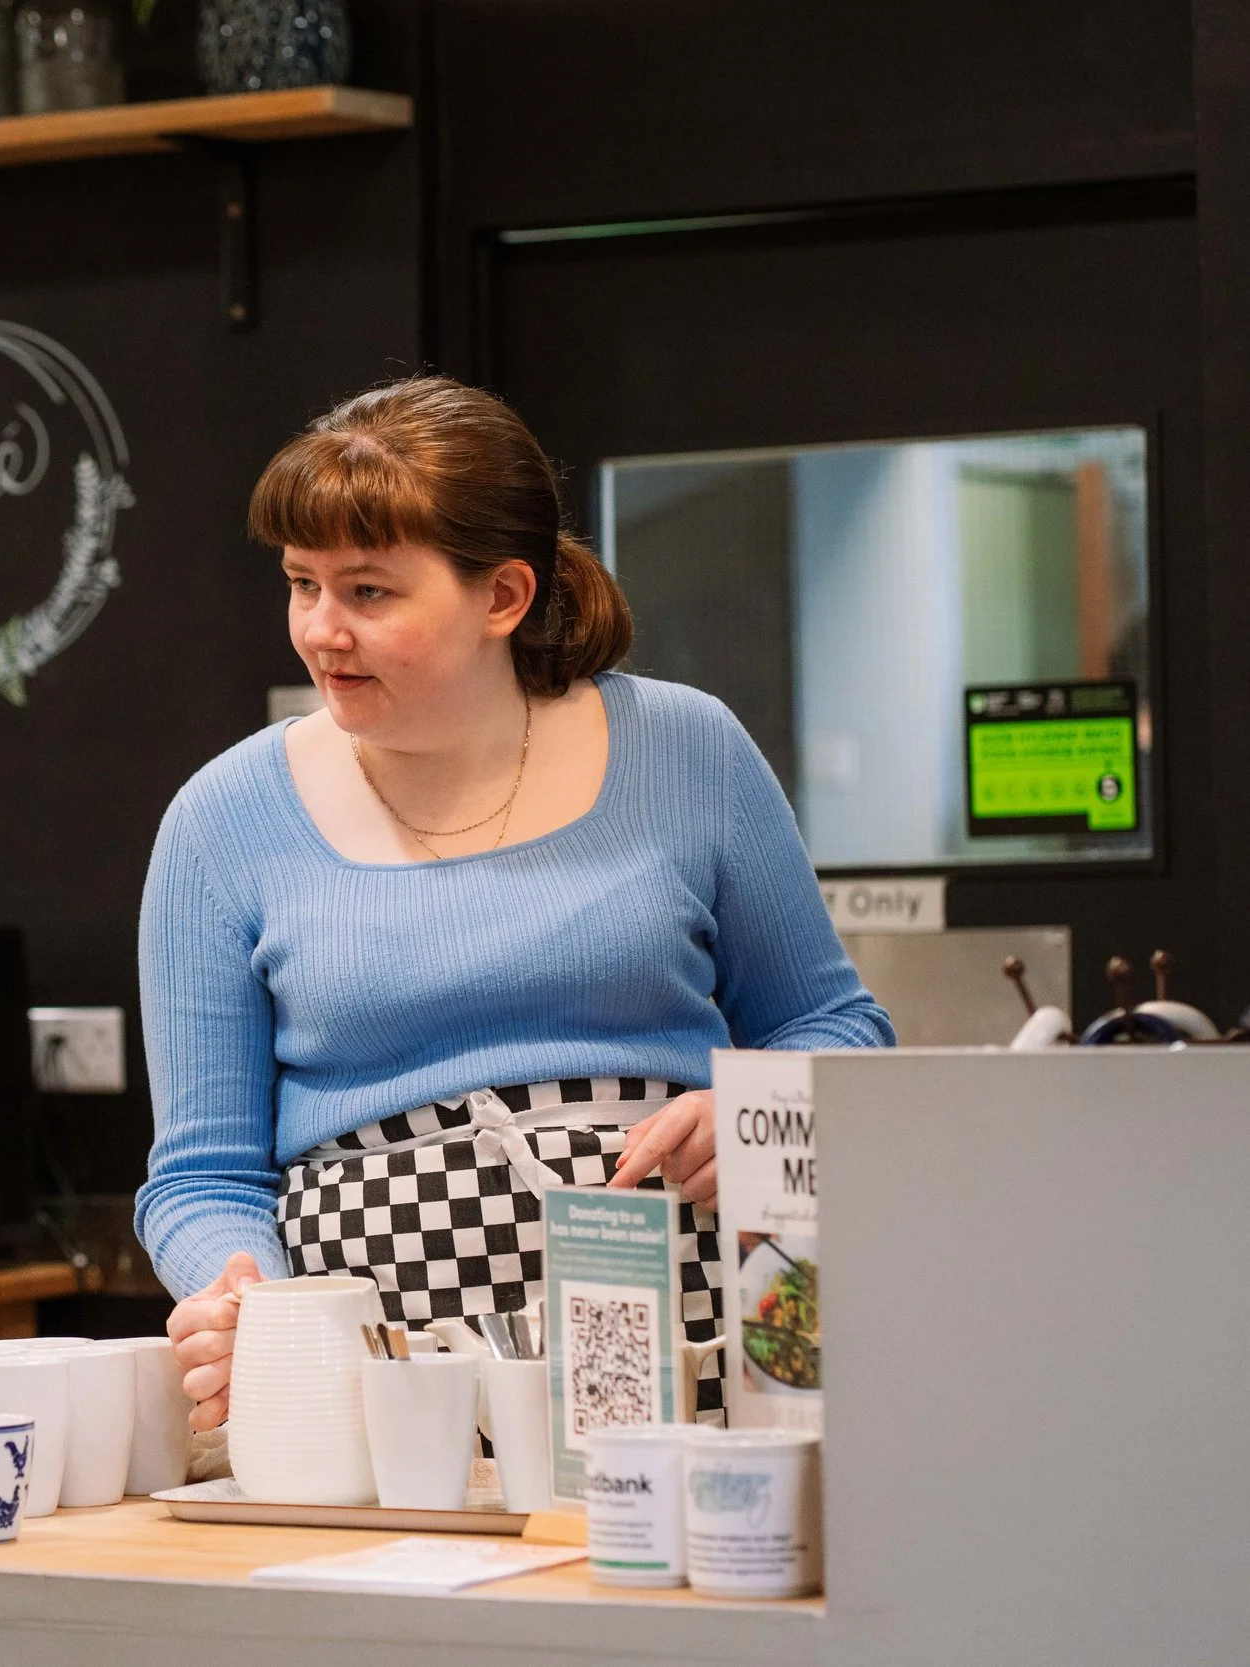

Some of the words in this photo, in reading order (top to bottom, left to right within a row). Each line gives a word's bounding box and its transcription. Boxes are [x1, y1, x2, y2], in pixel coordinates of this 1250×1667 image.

[847, 885, 925, 922] Only
[568, 1203, 619, 1227] Donating
[619, 1209, 631, 1224] to
[632, 1213, 647, 1225] us
[550, 1220, 569, 1237] has
[570, 1224, 600, 1239] never
[600, 1224, 628, 1241] been
[587, 1471, 653, 1494] dbank
